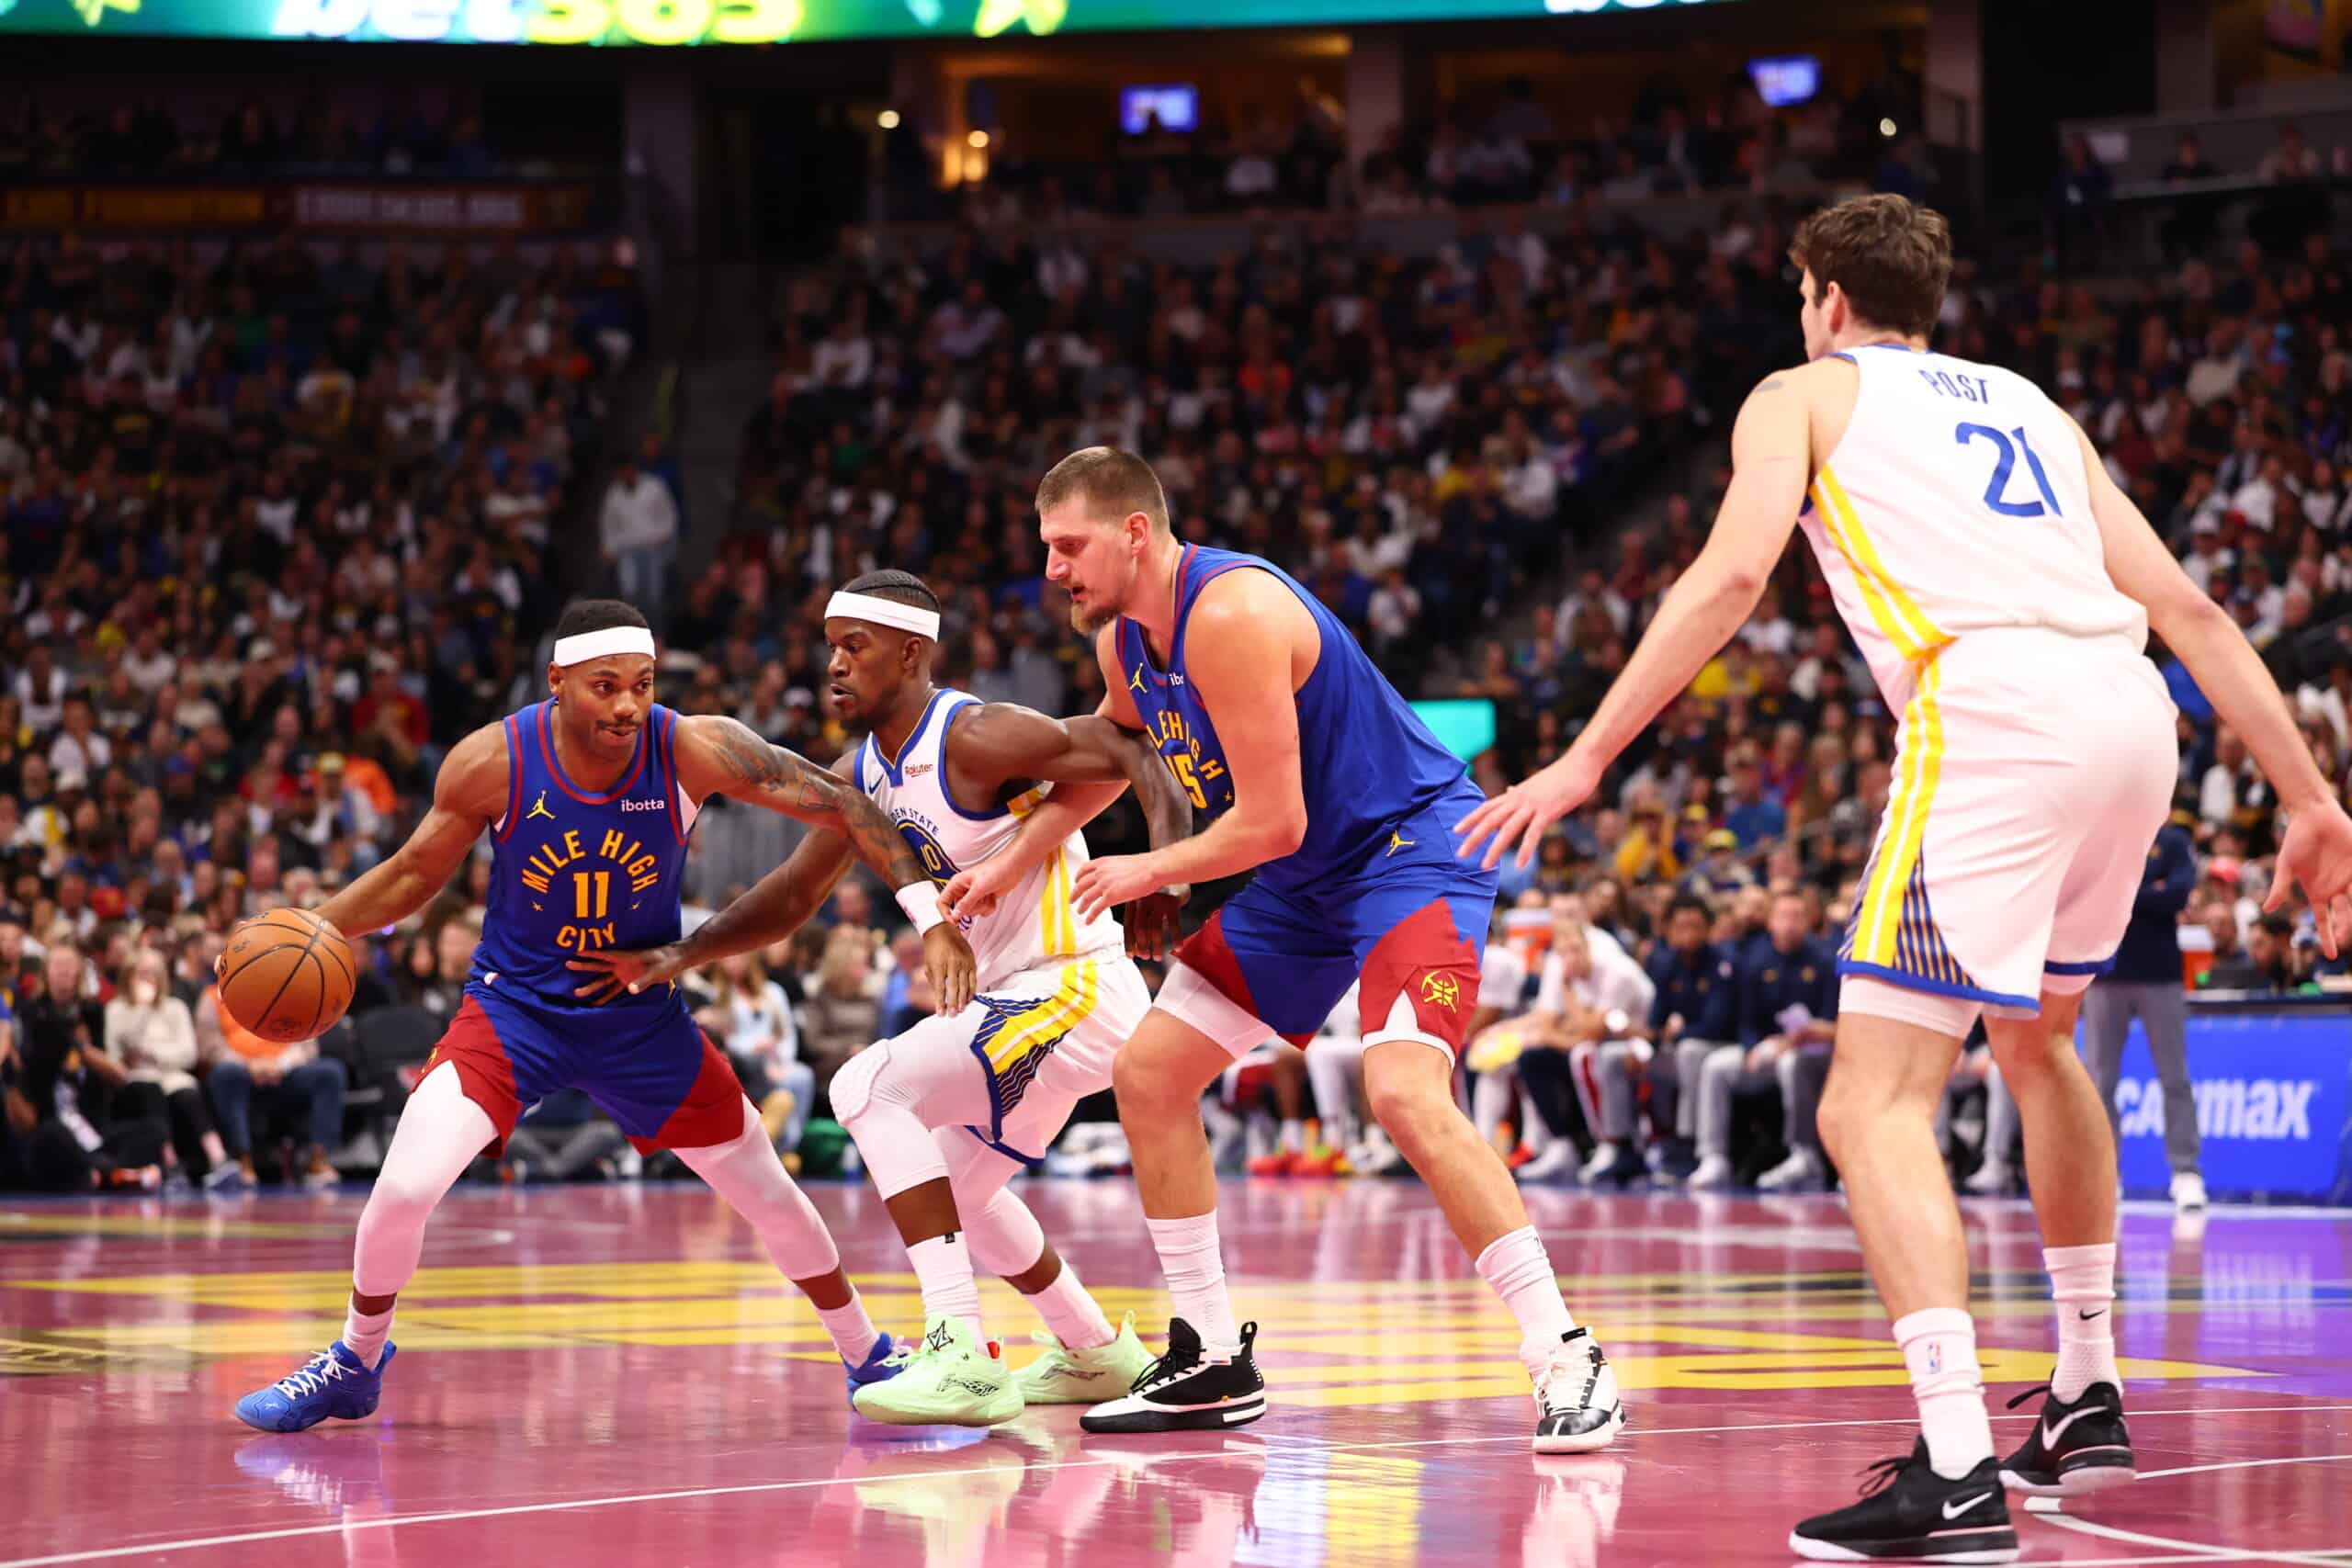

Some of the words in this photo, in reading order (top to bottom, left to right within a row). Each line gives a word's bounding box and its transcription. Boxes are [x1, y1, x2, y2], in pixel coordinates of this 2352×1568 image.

[1918, 369, 1989, 404] POST
[1955, 422, 2063, 518] 21
[904, 764, 933, 777] Rakuten
[620, 798, 665, 813] ibotta
[910, 808, 939, 835] STATE
[522, 829, 586, 894] MILE
[599, 829, 660, 893] HIGH
[572, 871, 610, 919] 11
[555, 921, 616, 953] CITY
